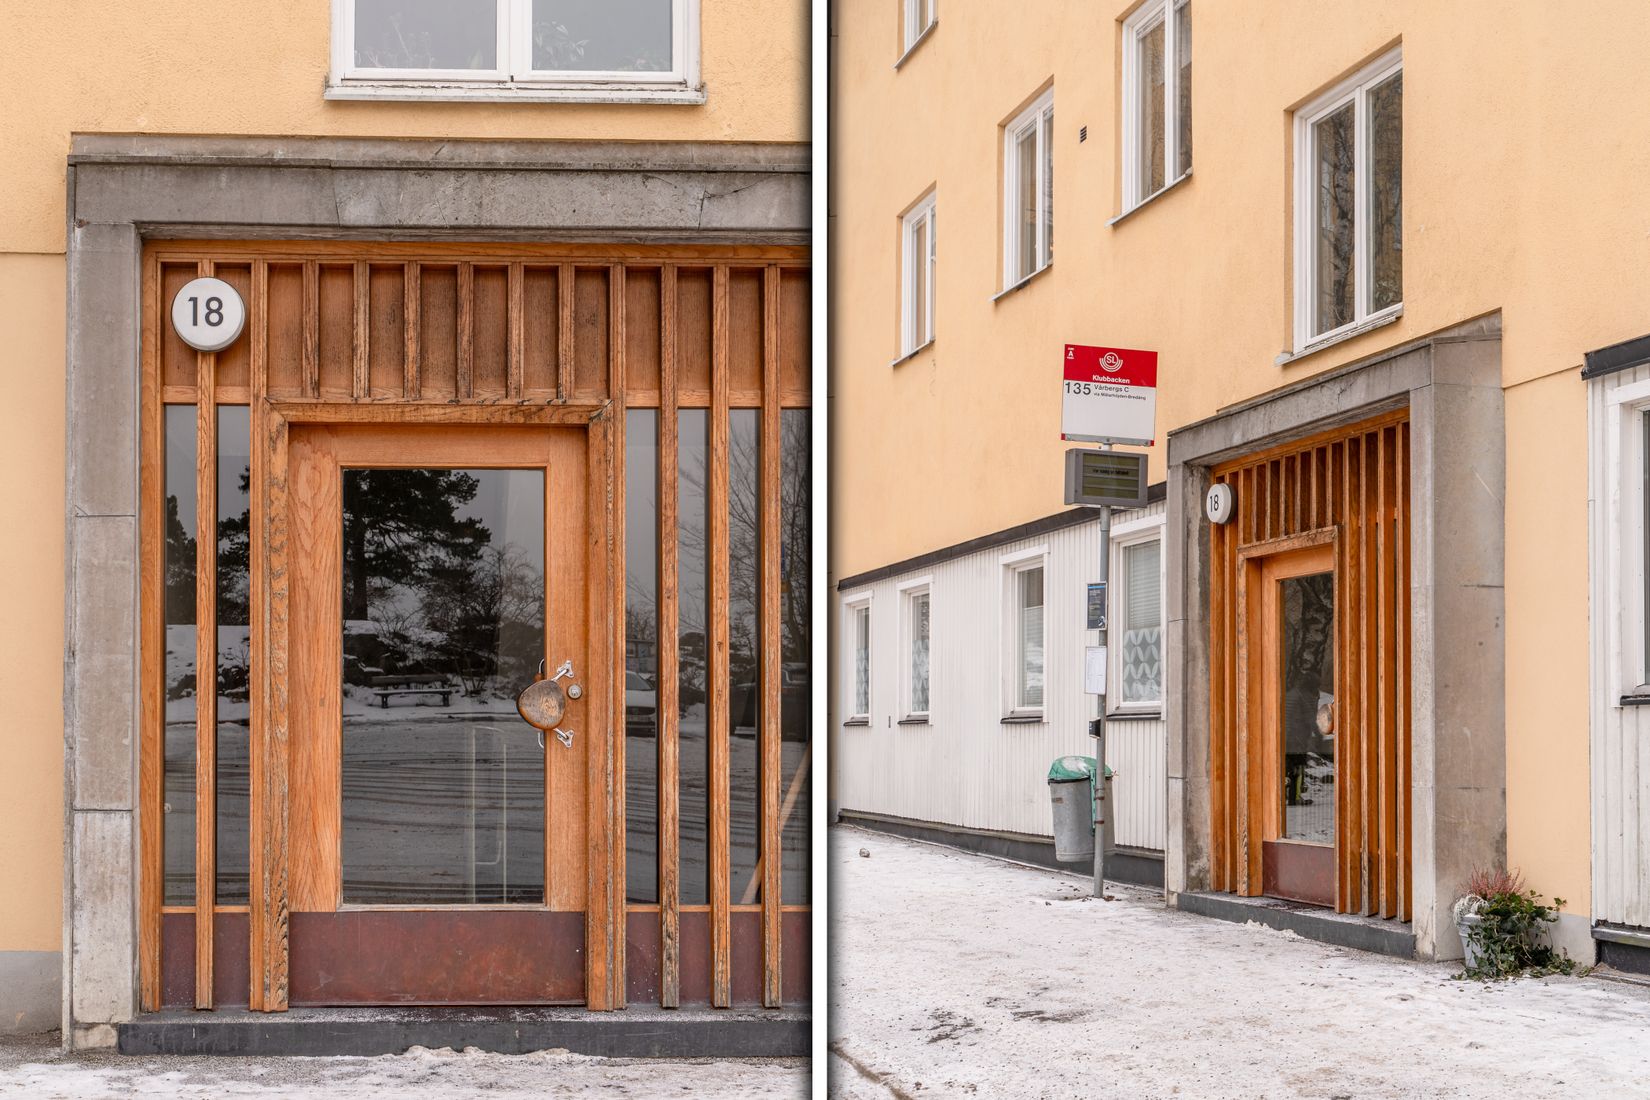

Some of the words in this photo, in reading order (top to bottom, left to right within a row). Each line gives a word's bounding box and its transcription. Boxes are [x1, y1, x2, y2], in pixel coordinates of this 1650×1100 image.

[188, 297, 224, 327] 18
[1106, 356, 1116, 364] SL
[1092, 374, 1130, 384] Klubbacken
[1065, 382, 1091, 395] 135
[1094, 384, 1122, 392] Vårbergs
[1210, 494, 1219, 512] 18
